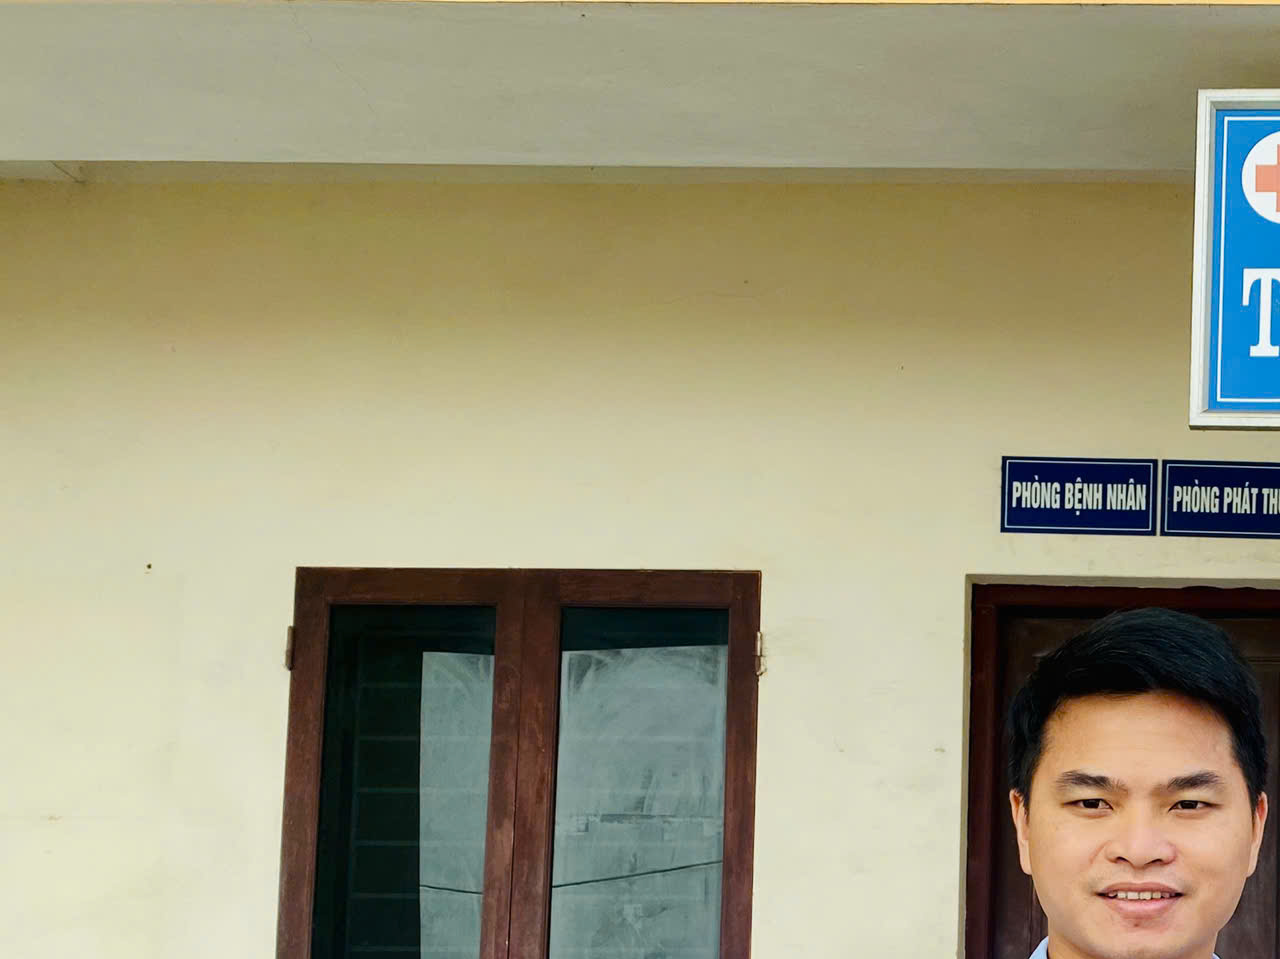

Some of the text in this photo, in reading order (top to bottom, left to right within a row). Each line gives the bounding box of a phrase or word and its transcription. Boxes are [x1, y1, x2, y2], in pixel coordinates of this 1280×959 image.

[1012, 475, 1147, 516] PHÒNG BỆNH NHÂN
[1172, 479, 1220, 514] PHÒNG
[1223, 481, 1259, 514] PHÁT
